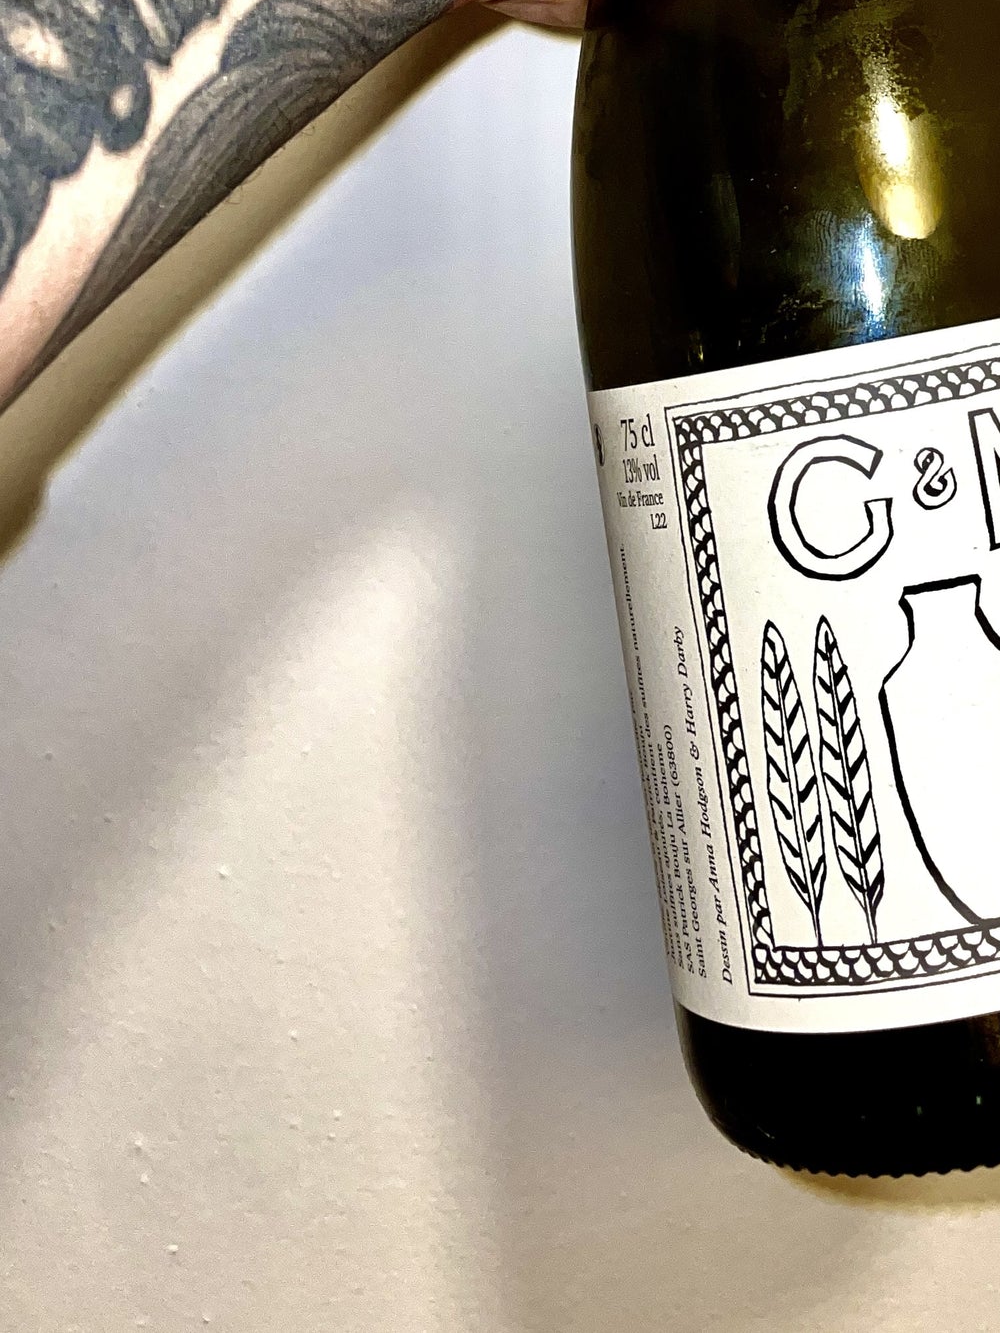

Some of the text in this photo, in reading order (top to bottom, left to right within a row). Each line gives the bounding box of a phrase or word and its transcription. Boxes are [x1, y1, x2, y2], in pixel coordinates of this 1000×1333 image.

[620, 413, 655, 451] 75 cl
[622, 454, 661, 483] 13% vol
[616, 490, 664, 507] Vin de France
[767, 434, 894, 581] G
[912, 447, 958, 510] &
[634, 656, 647, 708] sulfites
[642, 713, 652, 738] des
[647, 743, 661, 804] contient
[666, 810, 674, 828] La
[673, 625, 733, 985] Dessin par Anna Hodgson & Harry Darby
[663, 724, 707, 978] Saint Georges sur Allier (63800)
[668, 834, 682, 878] Bouju
[666, 873, 679, 928] sulfites
[676, 883, 690, 937] Patrick
[675, 932, 684, 969] Sans
[684, 941, 695, 974] SAS
